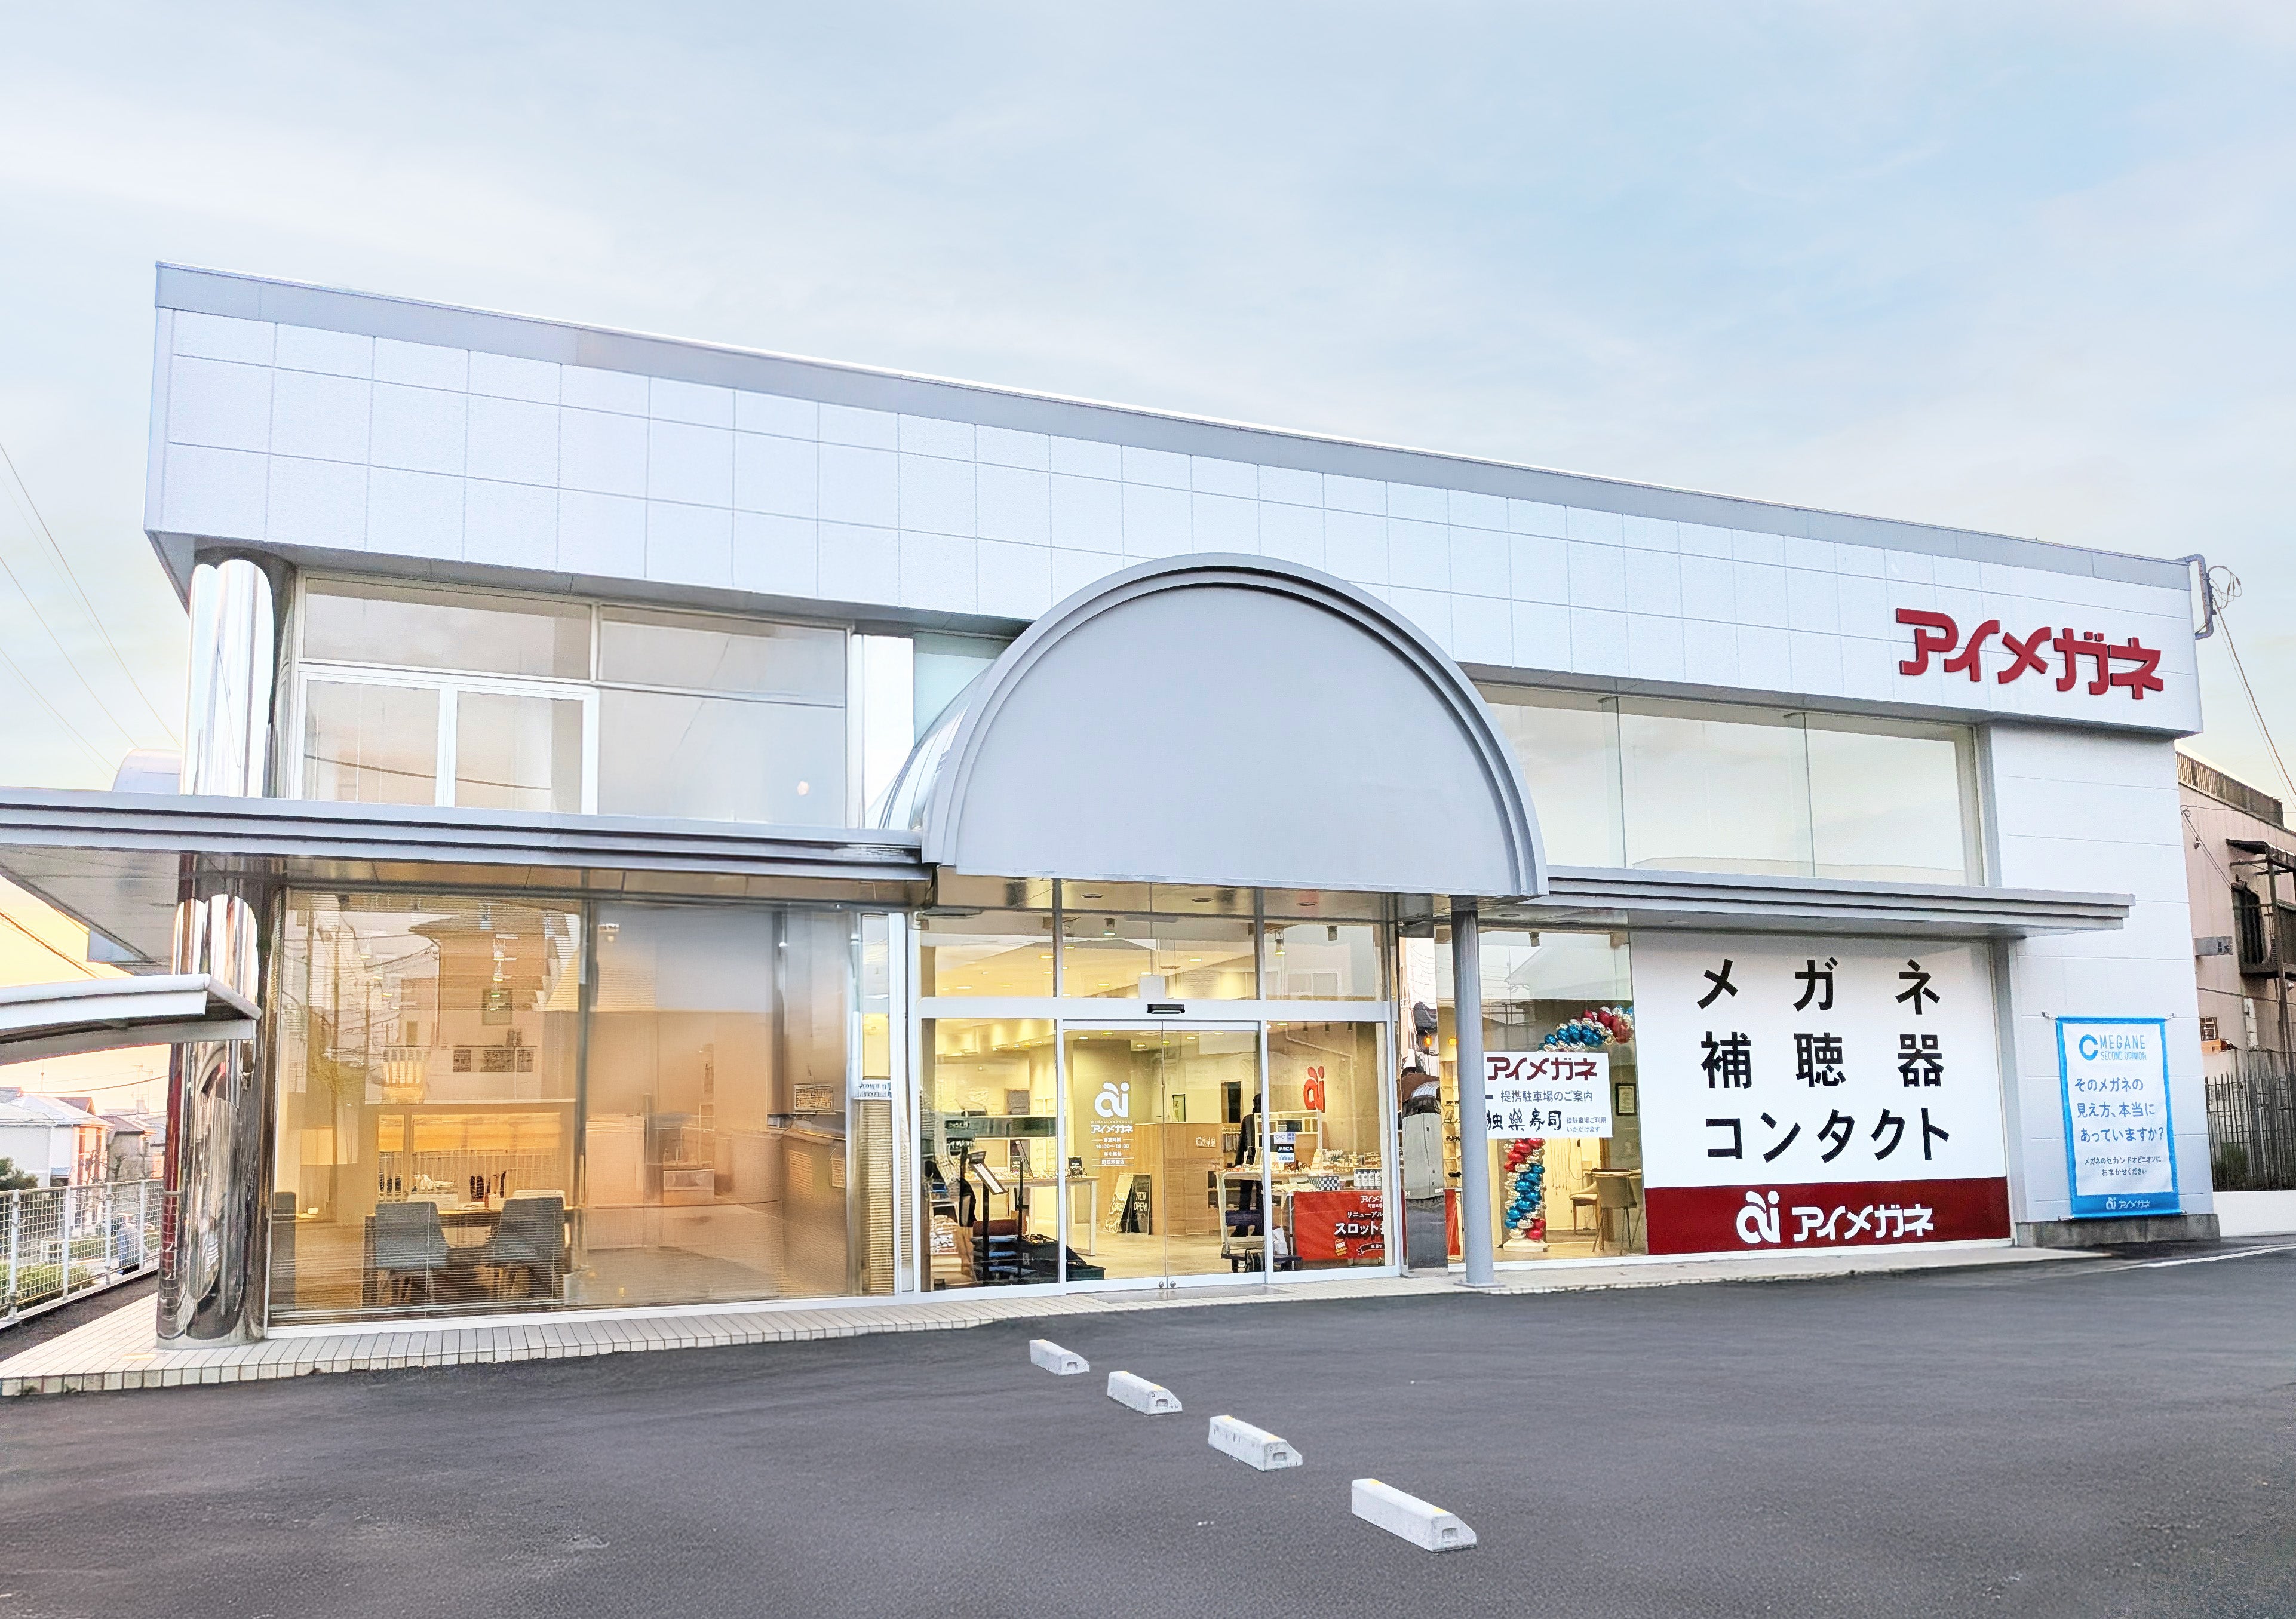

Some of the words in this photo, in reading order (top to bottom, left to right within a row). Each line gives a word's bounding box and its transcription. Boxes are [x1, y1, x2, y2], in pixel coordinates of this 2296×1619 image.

[1896, 607, 2164, 700] アイメガネ
[1486, 1056, 1597, 1081] アイメガネ
[1700, 1031, 1945, 1089] 補聴器
[2075, 1077, 2144, 1092] そのメガネの
[1500, 1090, 1593, 1102] 提携駐車場のご案内
[2077, 1102, 2155, 1118] 見え方、本当に
[1091, 1124, 1134, 1134] アイメガネ
[1706, 1107, 1950, 1163] コンタクト
[2085, 1156, 2162, 1165] メガネのセカンドオピニオンに
[1792, 1203, 1933, 1242] アイメガネ
